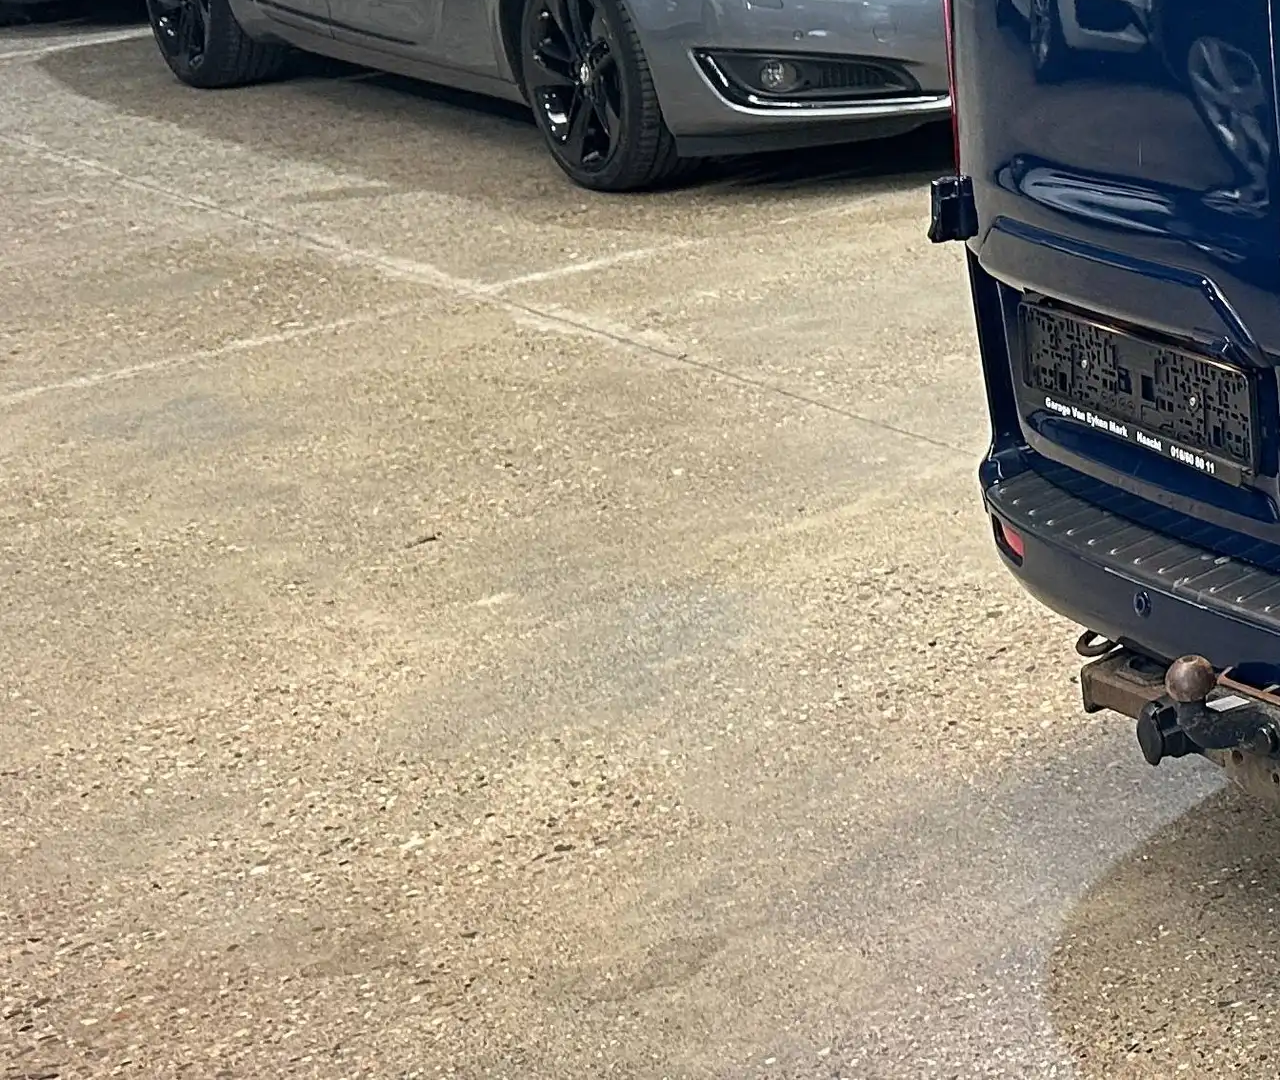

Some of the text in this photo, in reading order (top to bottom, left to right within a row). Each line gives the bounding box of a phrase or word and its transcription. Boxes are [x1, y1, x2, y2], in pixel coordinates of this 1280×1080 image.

[1045, 396, 1071, 417] Garage
[1071, 406, 1086, 422] Van
[1086, 412, 1109, 428] Eyken
[1109, 420, 1129, 438] Mark
[1205, 460, 1215, 474] 11
